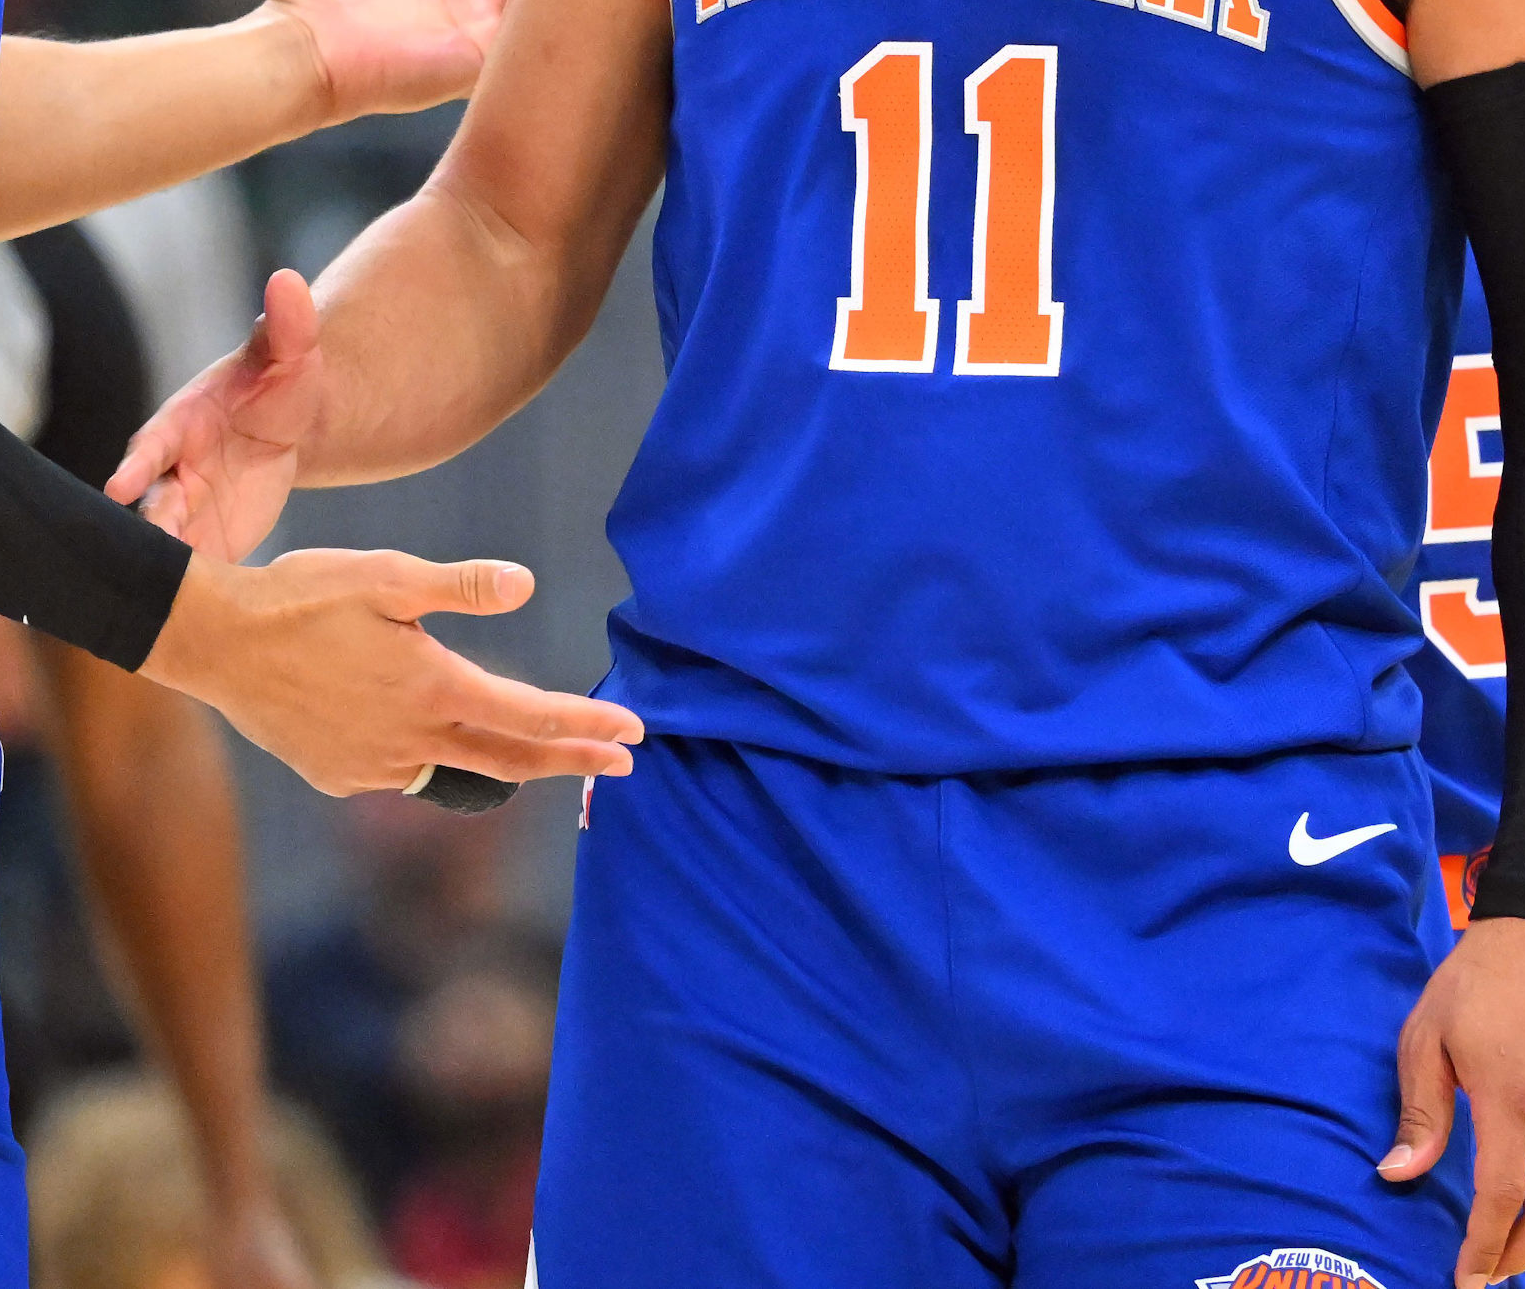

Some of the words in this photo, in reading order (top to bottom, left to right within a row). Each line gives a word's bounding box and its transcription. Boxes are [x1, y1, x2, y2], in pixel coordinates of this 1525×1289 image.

[828, 41, 1064, 377] 11
[1274, 1253, 1310, 1267] NEW
[1315, 1254, 1354, 1279] YORK
